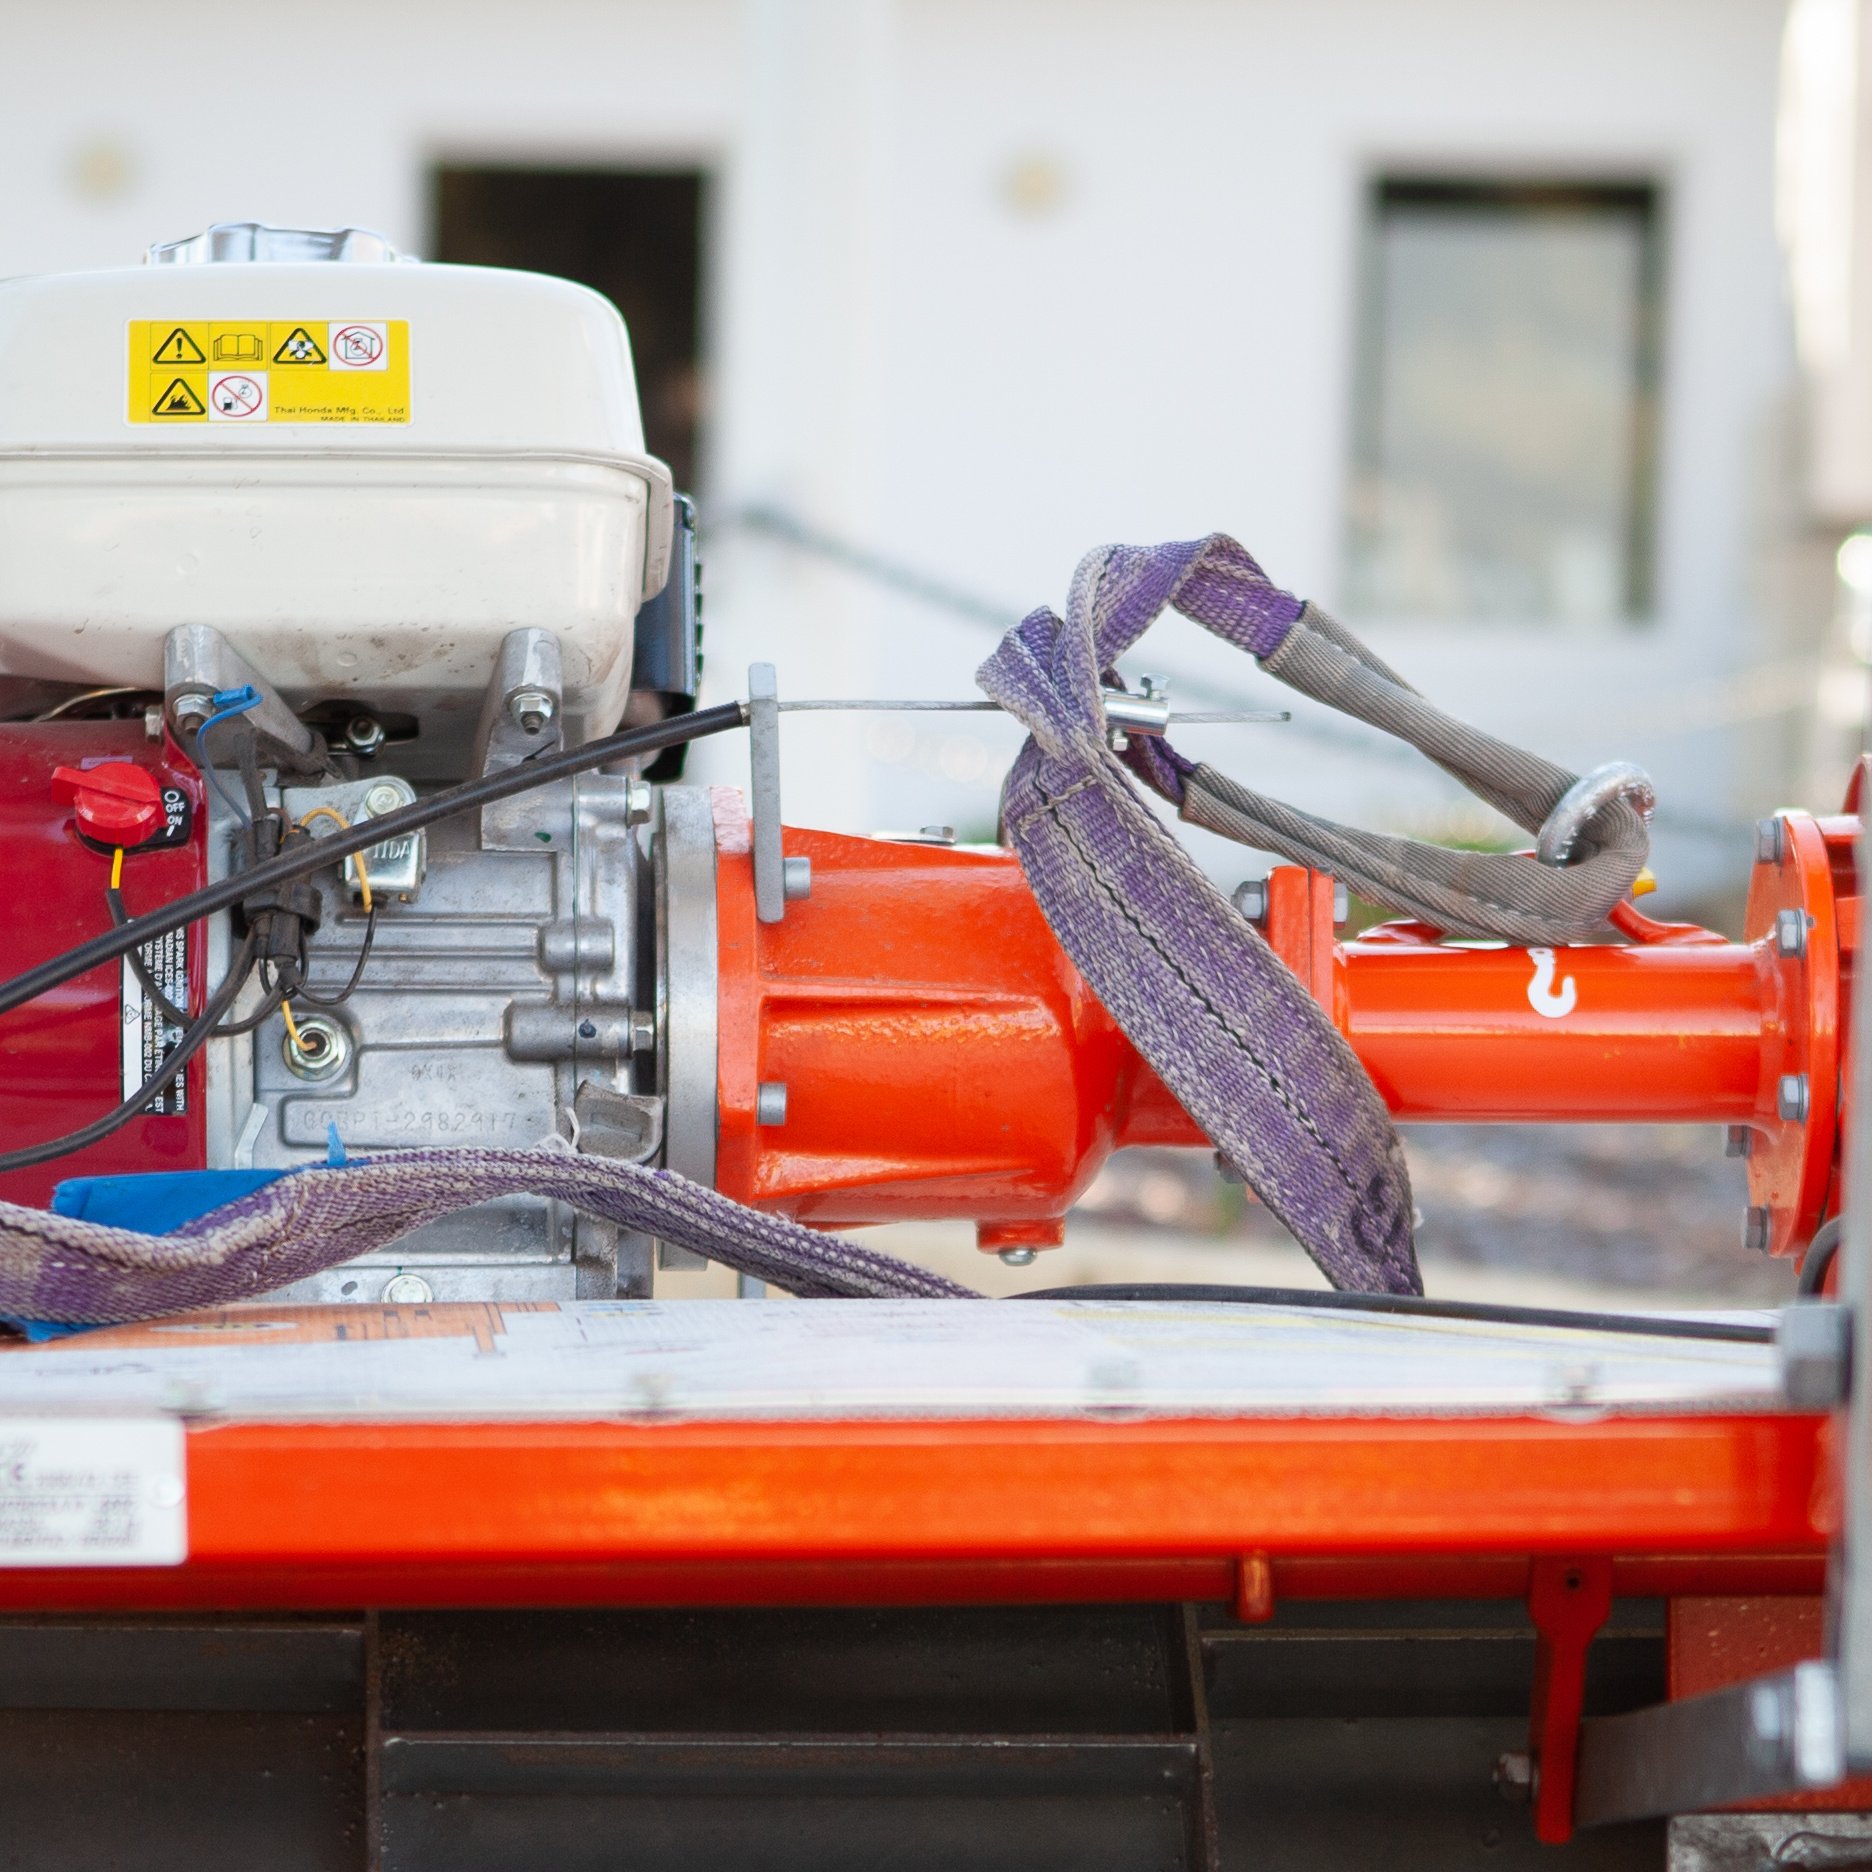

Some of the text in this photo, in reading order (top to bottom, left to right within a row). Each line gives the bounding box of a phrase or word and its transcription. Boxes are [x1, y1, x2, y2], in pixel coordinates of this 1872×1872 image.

[275, 406, 296, 414] Thai
[299, 406, 332, 414] Honda
[165, 801, 185, 813] OFF
[167, 815, 183, 826] ON
[176, 940, 185, 969] SPARK
[175, 970, 184, 1008] IGNITION
[154, 1029, 164, 1048] PAR
[144, 1059, 152, 1072] DU
[154, 1096, 164, 1113] EST
[176, 1089, 184, 1110] WITH
